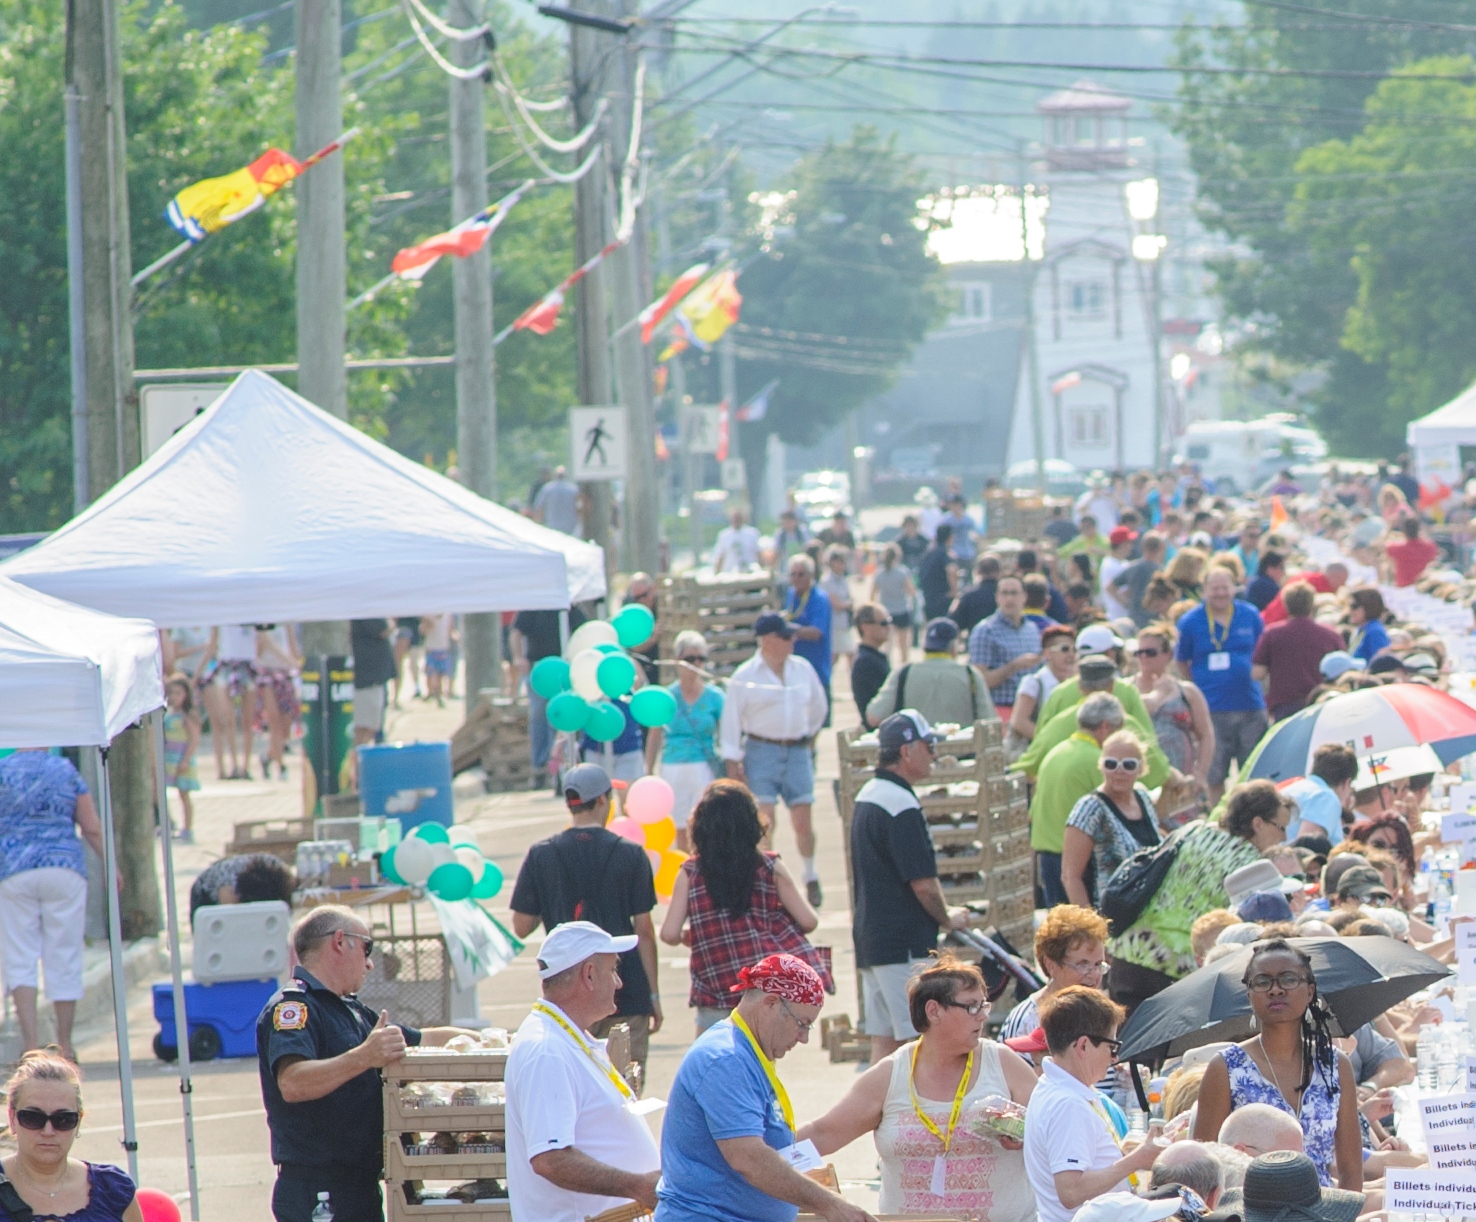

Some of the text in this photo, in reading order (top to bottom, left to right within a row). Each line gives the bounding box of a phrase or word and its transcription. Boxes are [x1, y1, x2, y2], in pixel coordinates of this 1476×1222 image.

[1425, 1103, 1458, 1114] Billets
[1433, 1143, 1466, 1153] Billets
[1393, 1181, 1431, 1191] Billets
[1394, 1199, 1451, 1209] Individual
